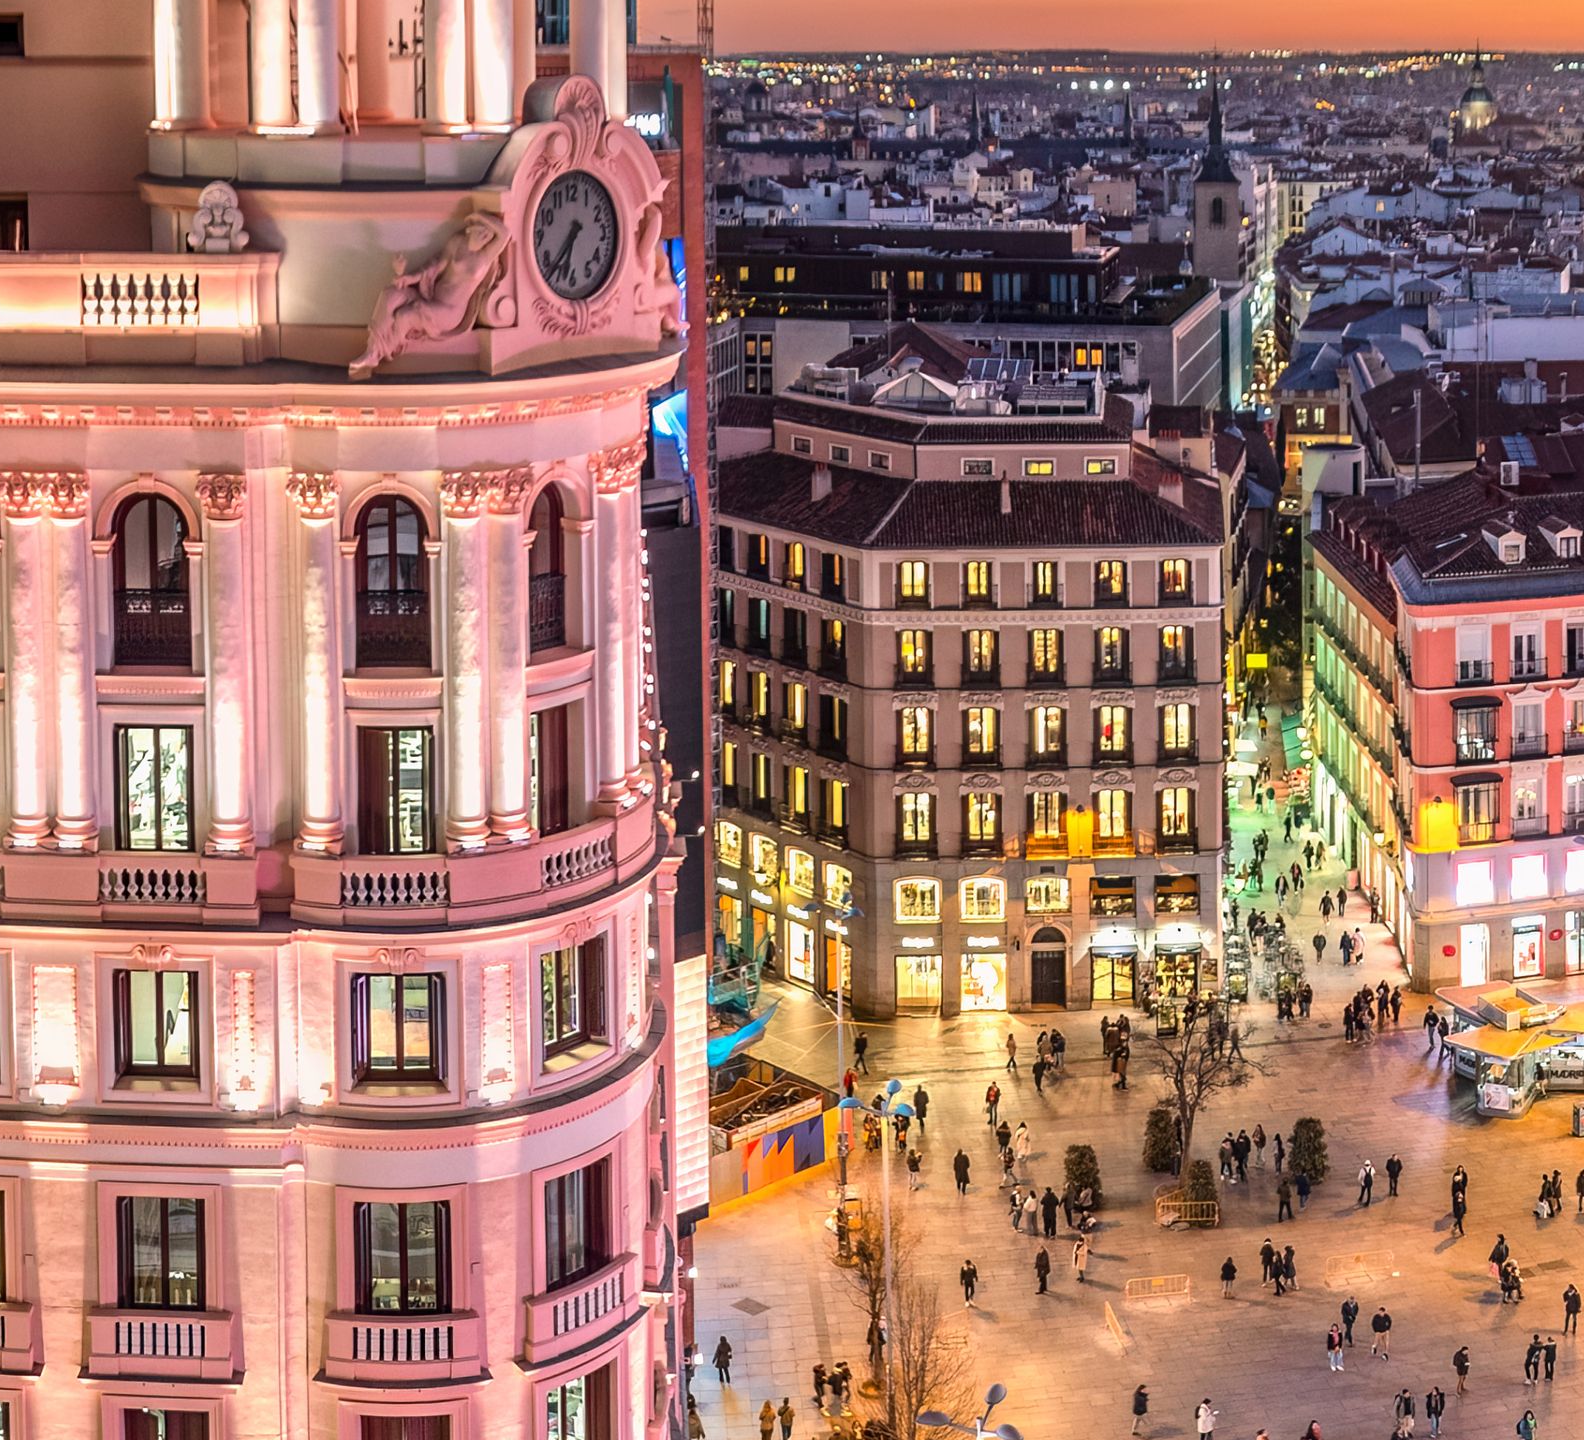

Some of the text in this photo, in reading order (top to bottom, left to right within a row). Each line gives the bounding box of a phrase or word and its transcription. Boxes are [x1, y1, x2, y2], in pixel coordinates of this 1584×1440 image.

[553, 191, 563, 209] 11
[565, 183, 579, 203] 12
[584, 189, 589, 207] 1
[541, 207, 554, 227] 10
[593, 205, 603, 223] 2
[568, 268, 577, 288] 6
[584, 259, 594, 279] 5
